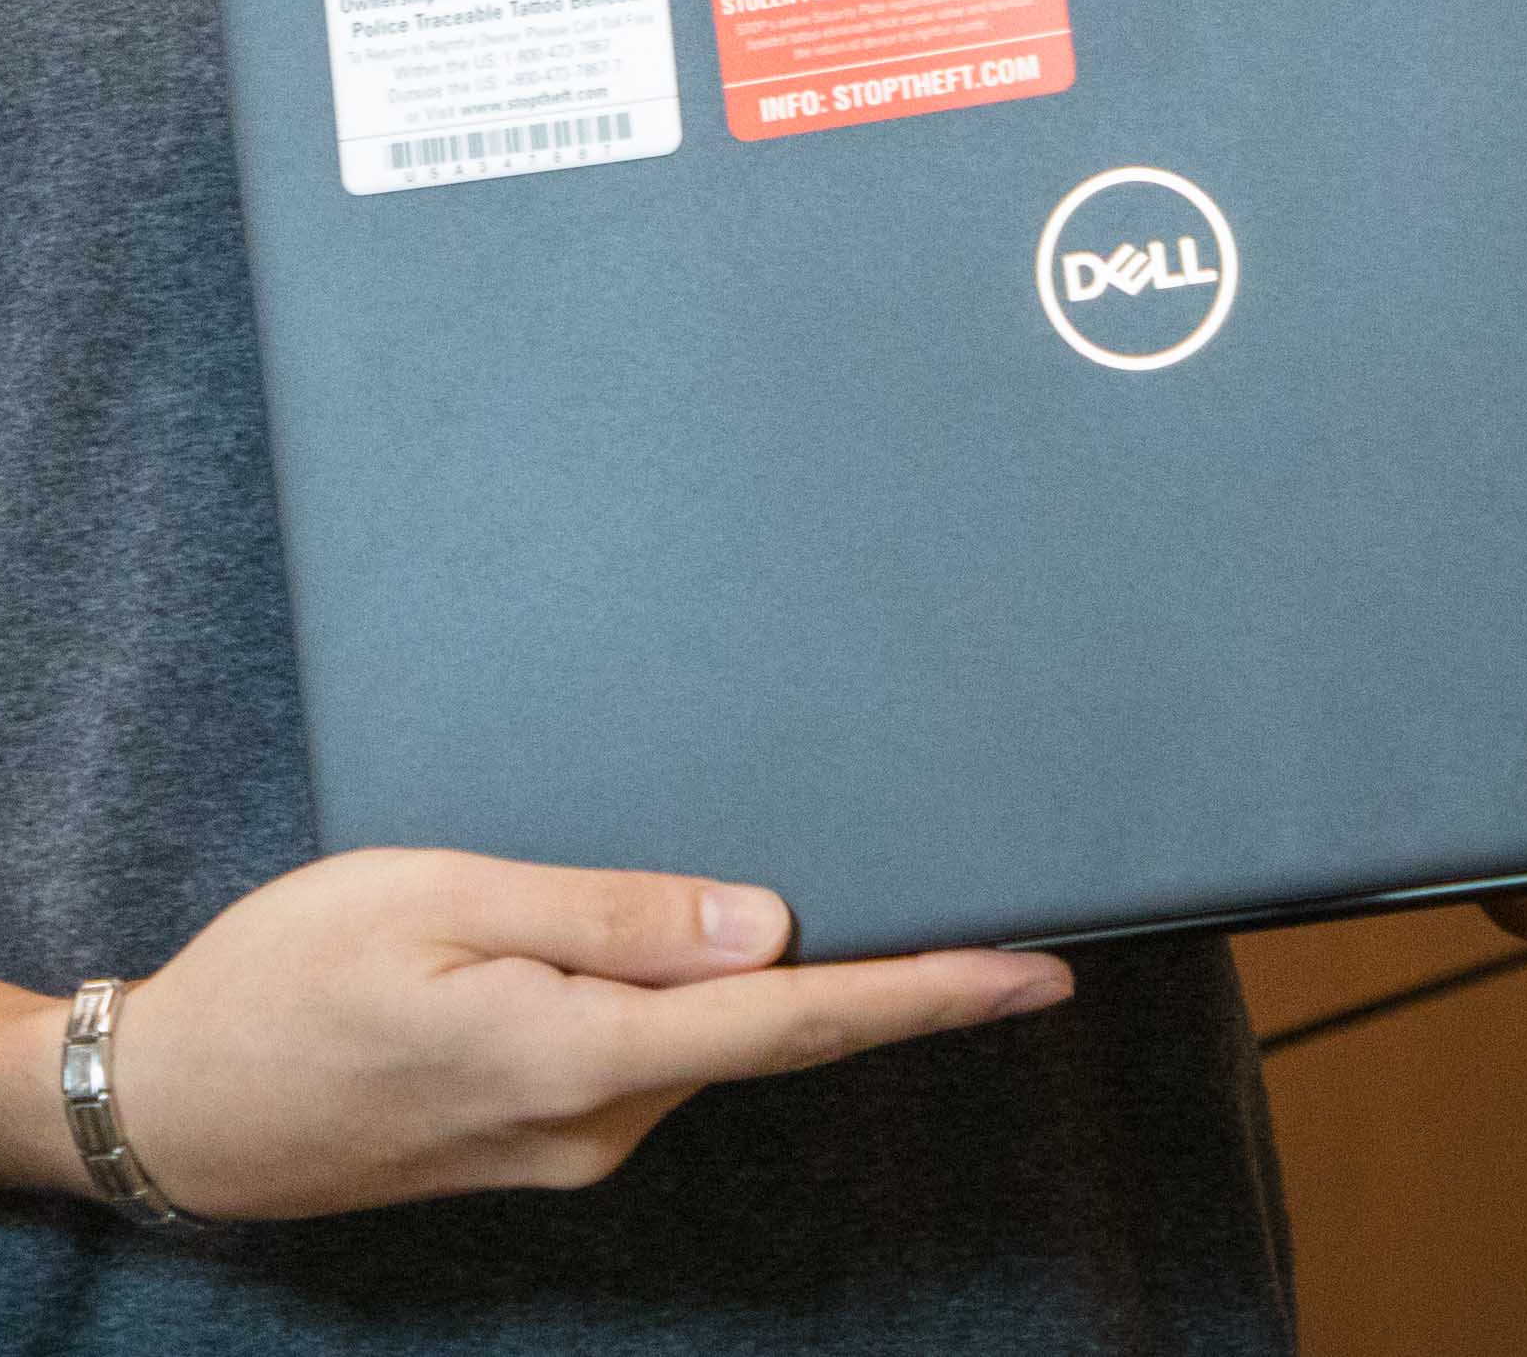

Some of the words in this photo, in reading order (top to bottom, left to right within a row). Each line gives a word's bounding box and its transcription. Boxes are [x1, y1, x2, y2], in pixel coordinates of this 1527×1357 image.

[351, 19, 410, 39] Police
[413, 5, 504, 30] Traceable
[459, 87, 609, 117] www.stoptheft.com
[758, 89, 828, 123] INFO:
[832, 53, 1042, 111] STOPTHEFT.COM
[1062, 235, 1219, 302] DELL
